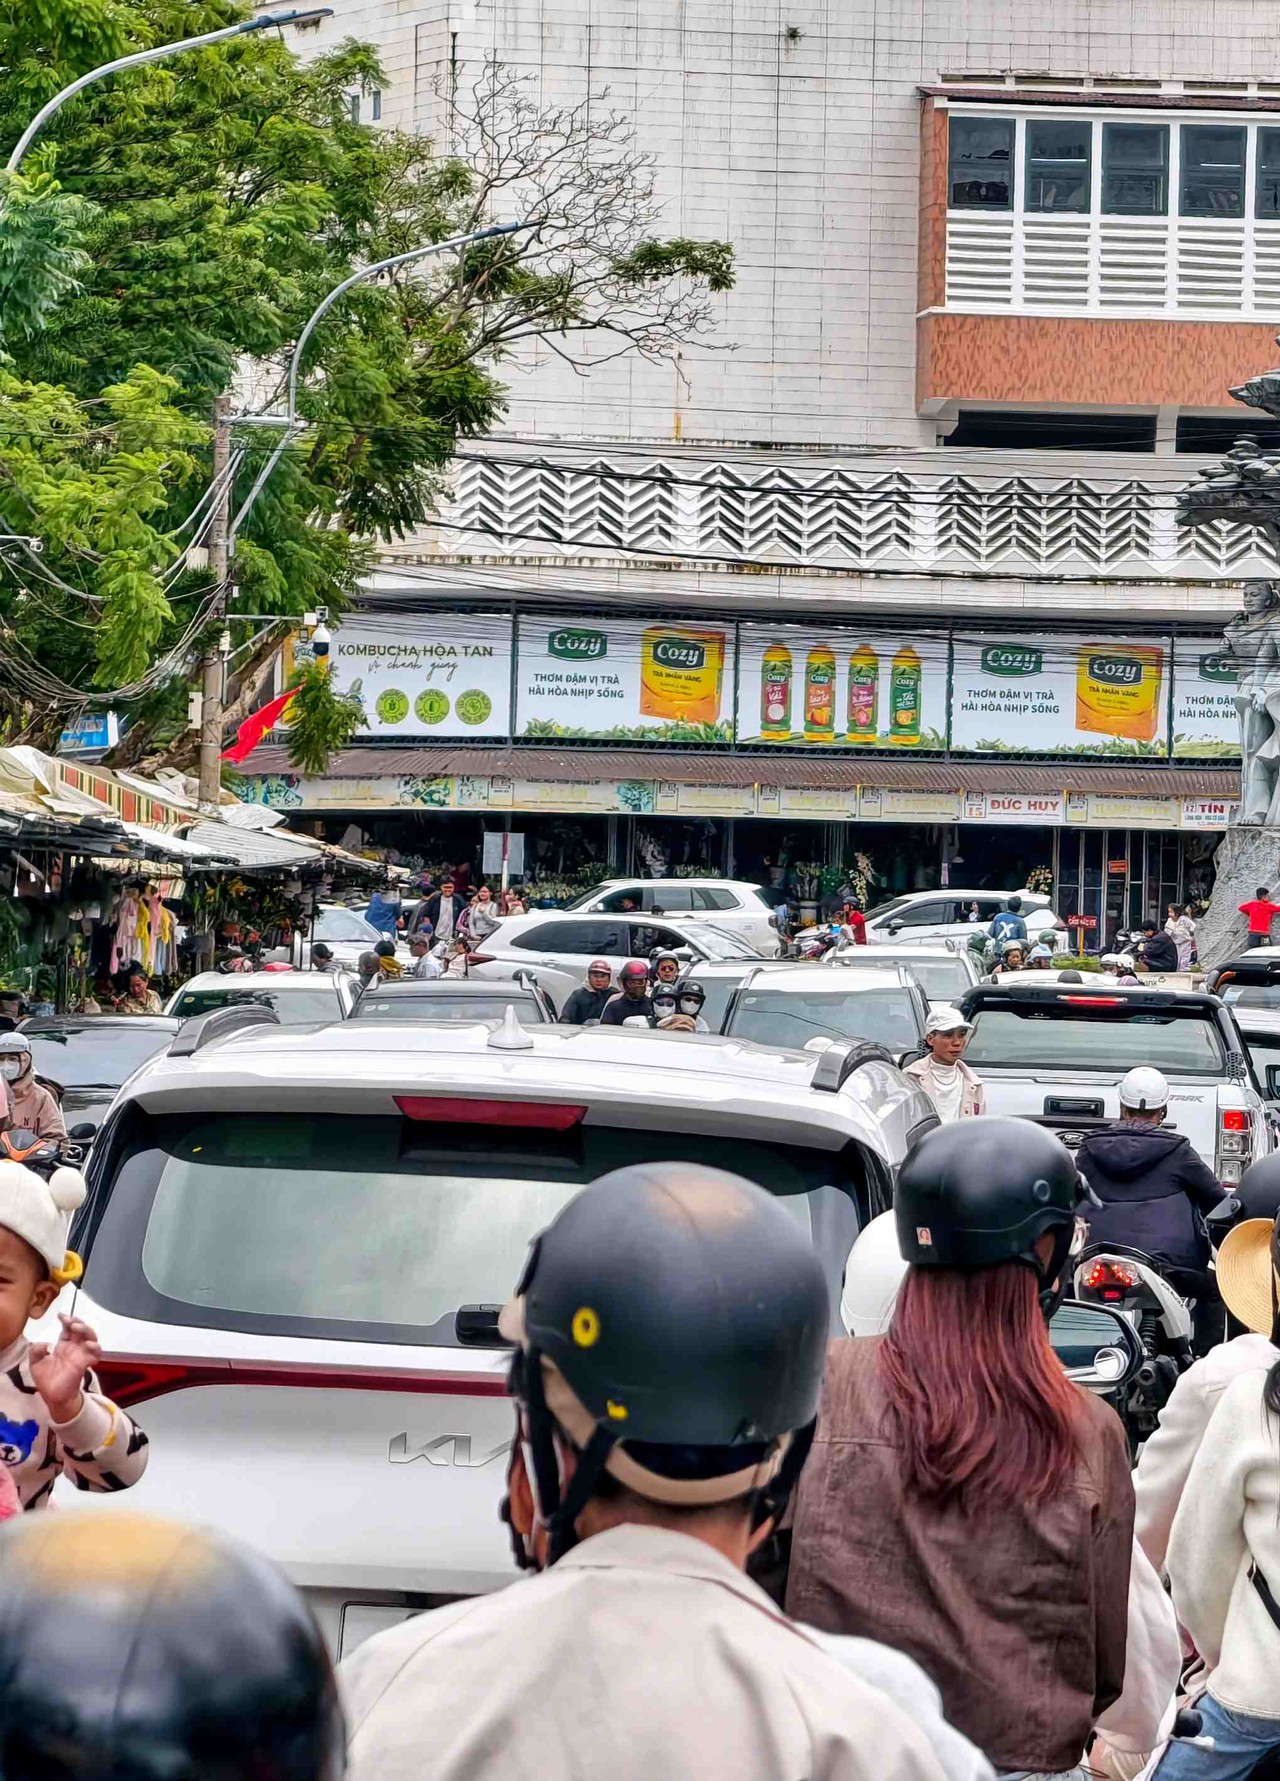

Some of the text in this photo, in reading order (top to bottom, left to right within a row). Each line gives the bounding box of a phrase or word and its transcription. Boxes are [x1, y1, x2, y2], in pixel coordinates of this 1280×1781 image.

[338, 642, 493, 657] KOMBUCHA HÒA TAN
[553, 633, 602, 655] Cozy
[656, 643, 700, 666] Cozy
[986, 649, 1037, 671] Cozy
[1093, 659, 1137, 682] Cozy
[1205, 657, 1230, 672] Co
[533, 672, 620, 686] THƠM ĐẬM VỊ TRÀ
[528, 684, 624, 699] HÀI HÒA NHỊP SỐNG
[967, 688, 1055, 702] THƠM ĐẬM VỊ TRÀ
[1185, 695, 1214, 705] THƠM
[961, 701, 1060, 715] HÀI HÒA NHỊP SỐNG
[1179, 707, 1237, 719] HÀI HÒA NH
[990, 797, 1059, 811] ĐỨC HUY
[1199, 802, 1224, 813] TÍN
[1169, 1094, 1204, 1103] TRAK
